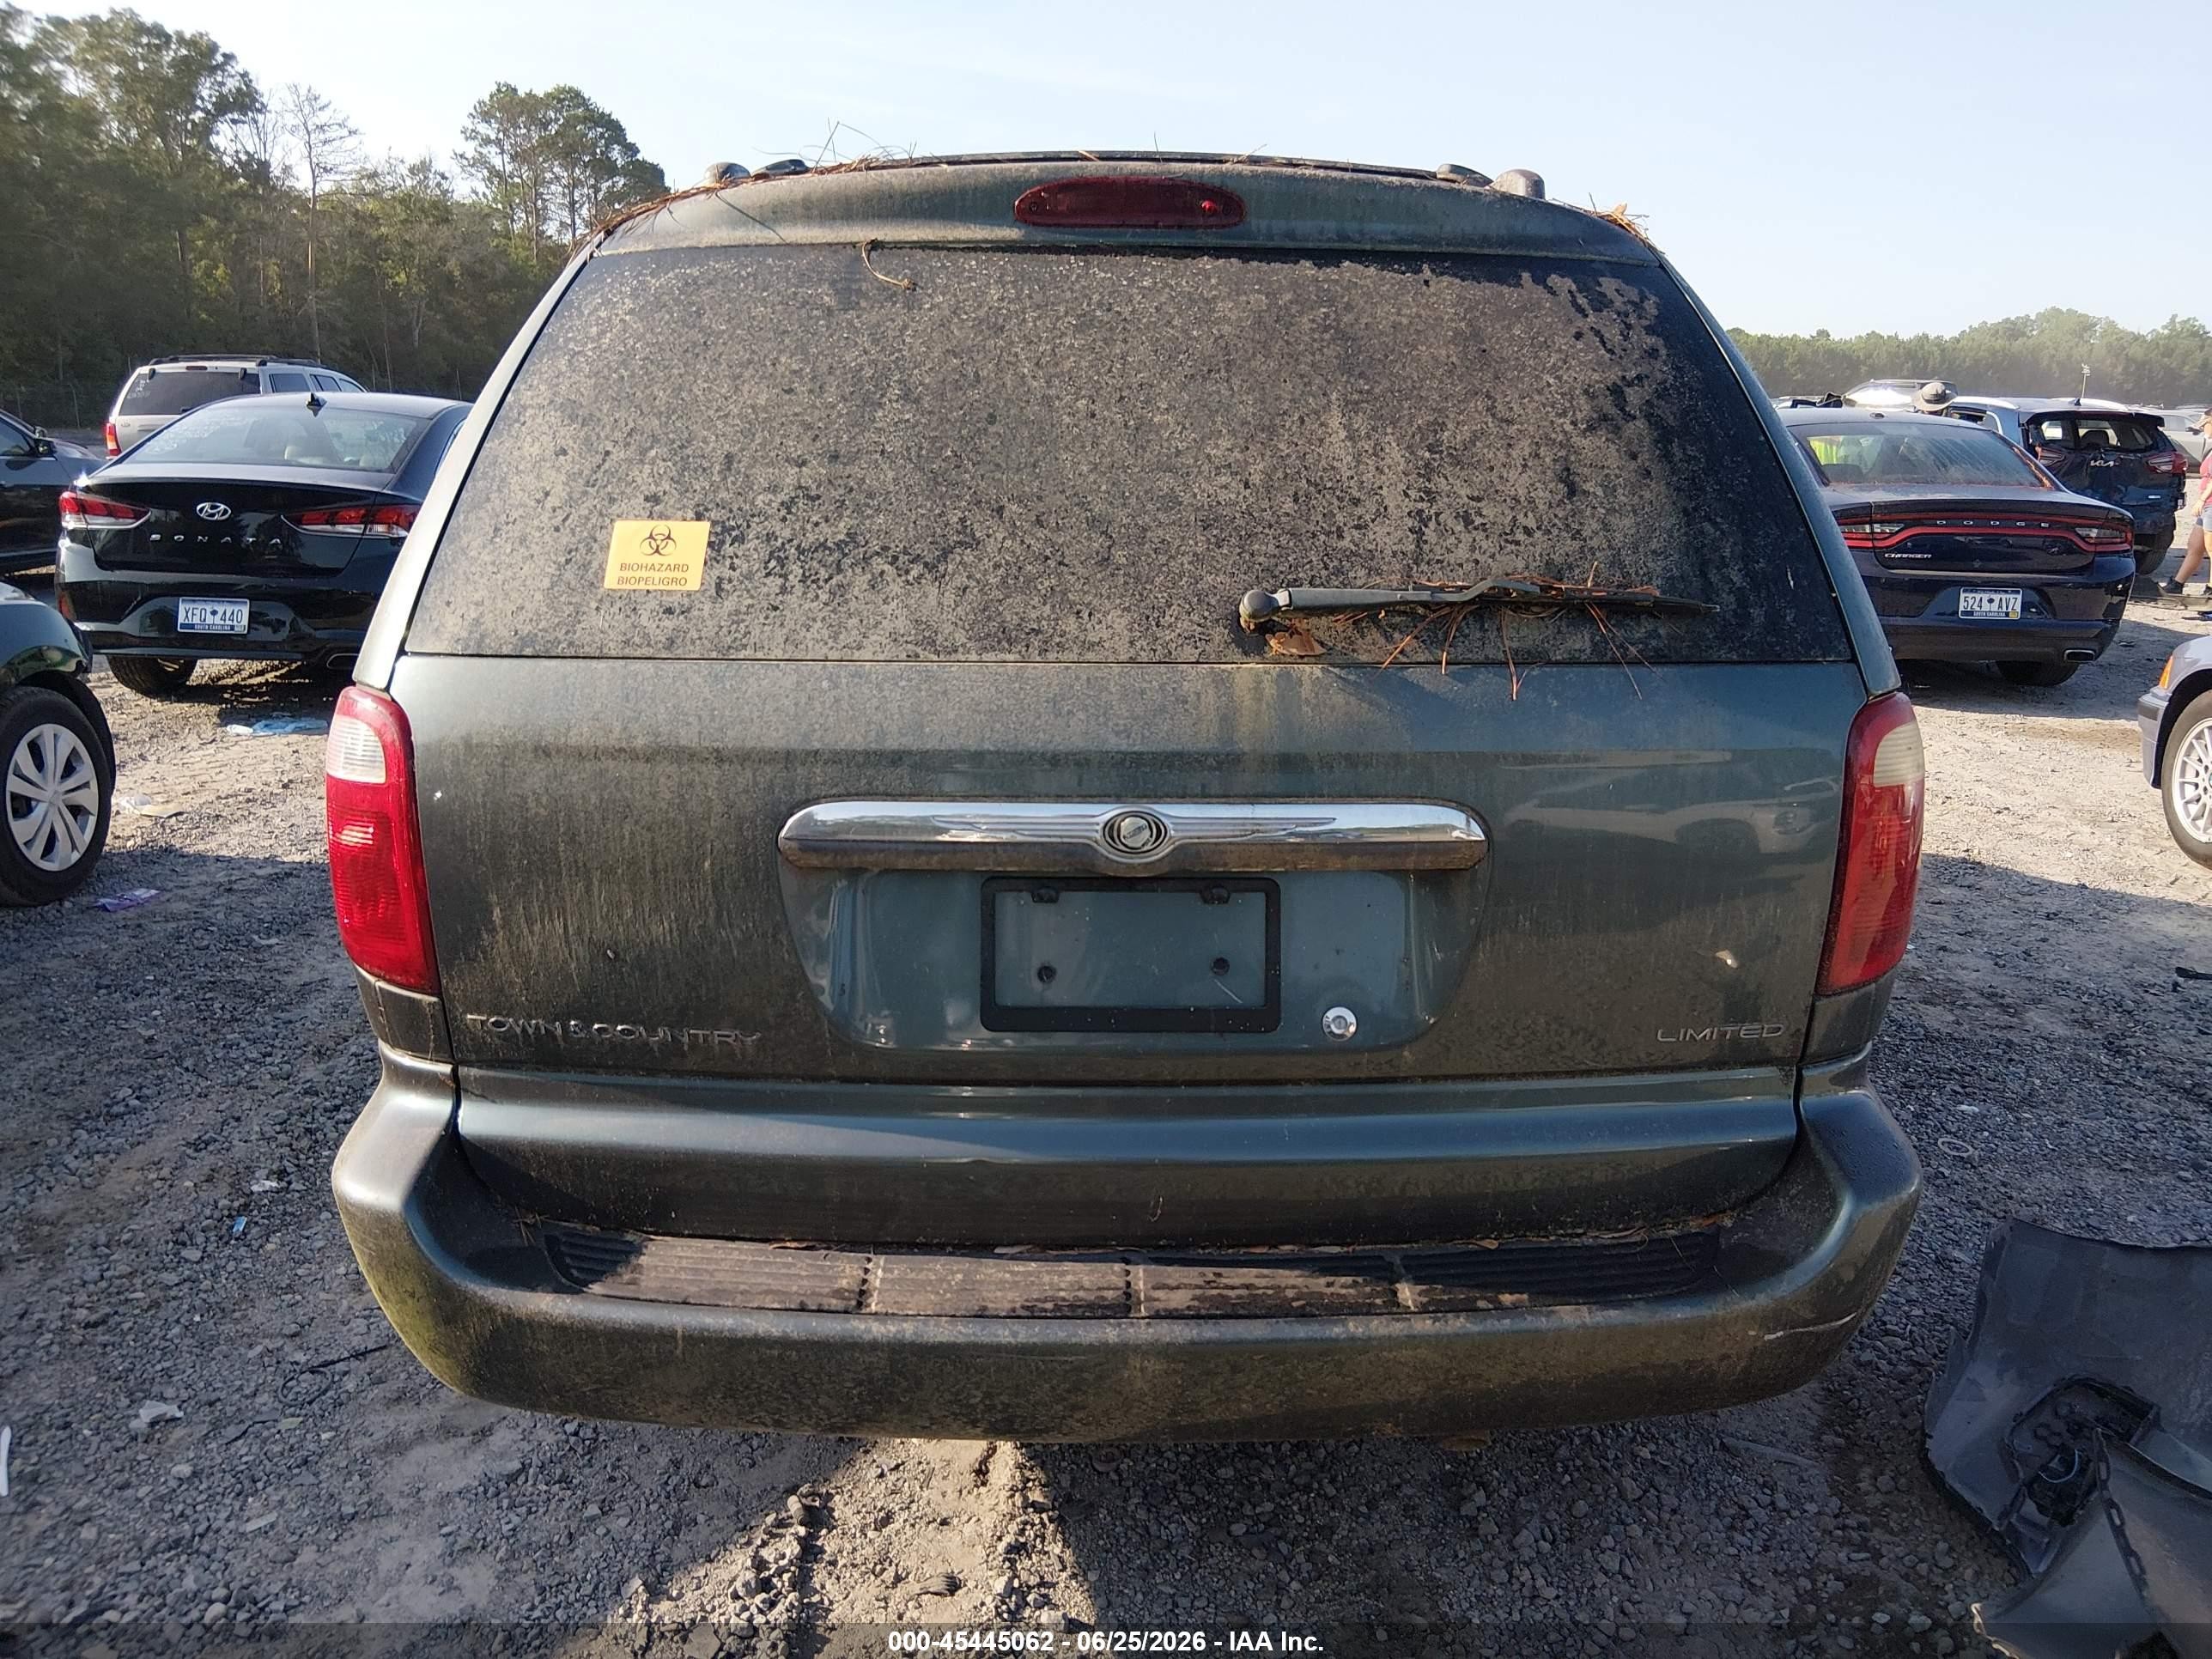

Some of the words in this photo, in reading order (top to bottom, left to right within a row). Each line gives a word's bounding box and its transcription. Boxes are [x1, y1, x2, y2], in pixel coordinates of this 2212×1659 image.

[1936, 520, 2050, 528] DODGE
[149, 533, 282, 544] SONATA
[619, 562, 690, 574] BIOHAZARD
[617, 576, 688, 586] BIOPELIGRO
[1963, 596, 1983, 611] 524
[1997, 597, 2018, 611] AVZ
[183, 606, 207, 623] XFQ
[220, 608, 243, 624] 440
[1656, 1024, 1785, 1042] LIMITED
